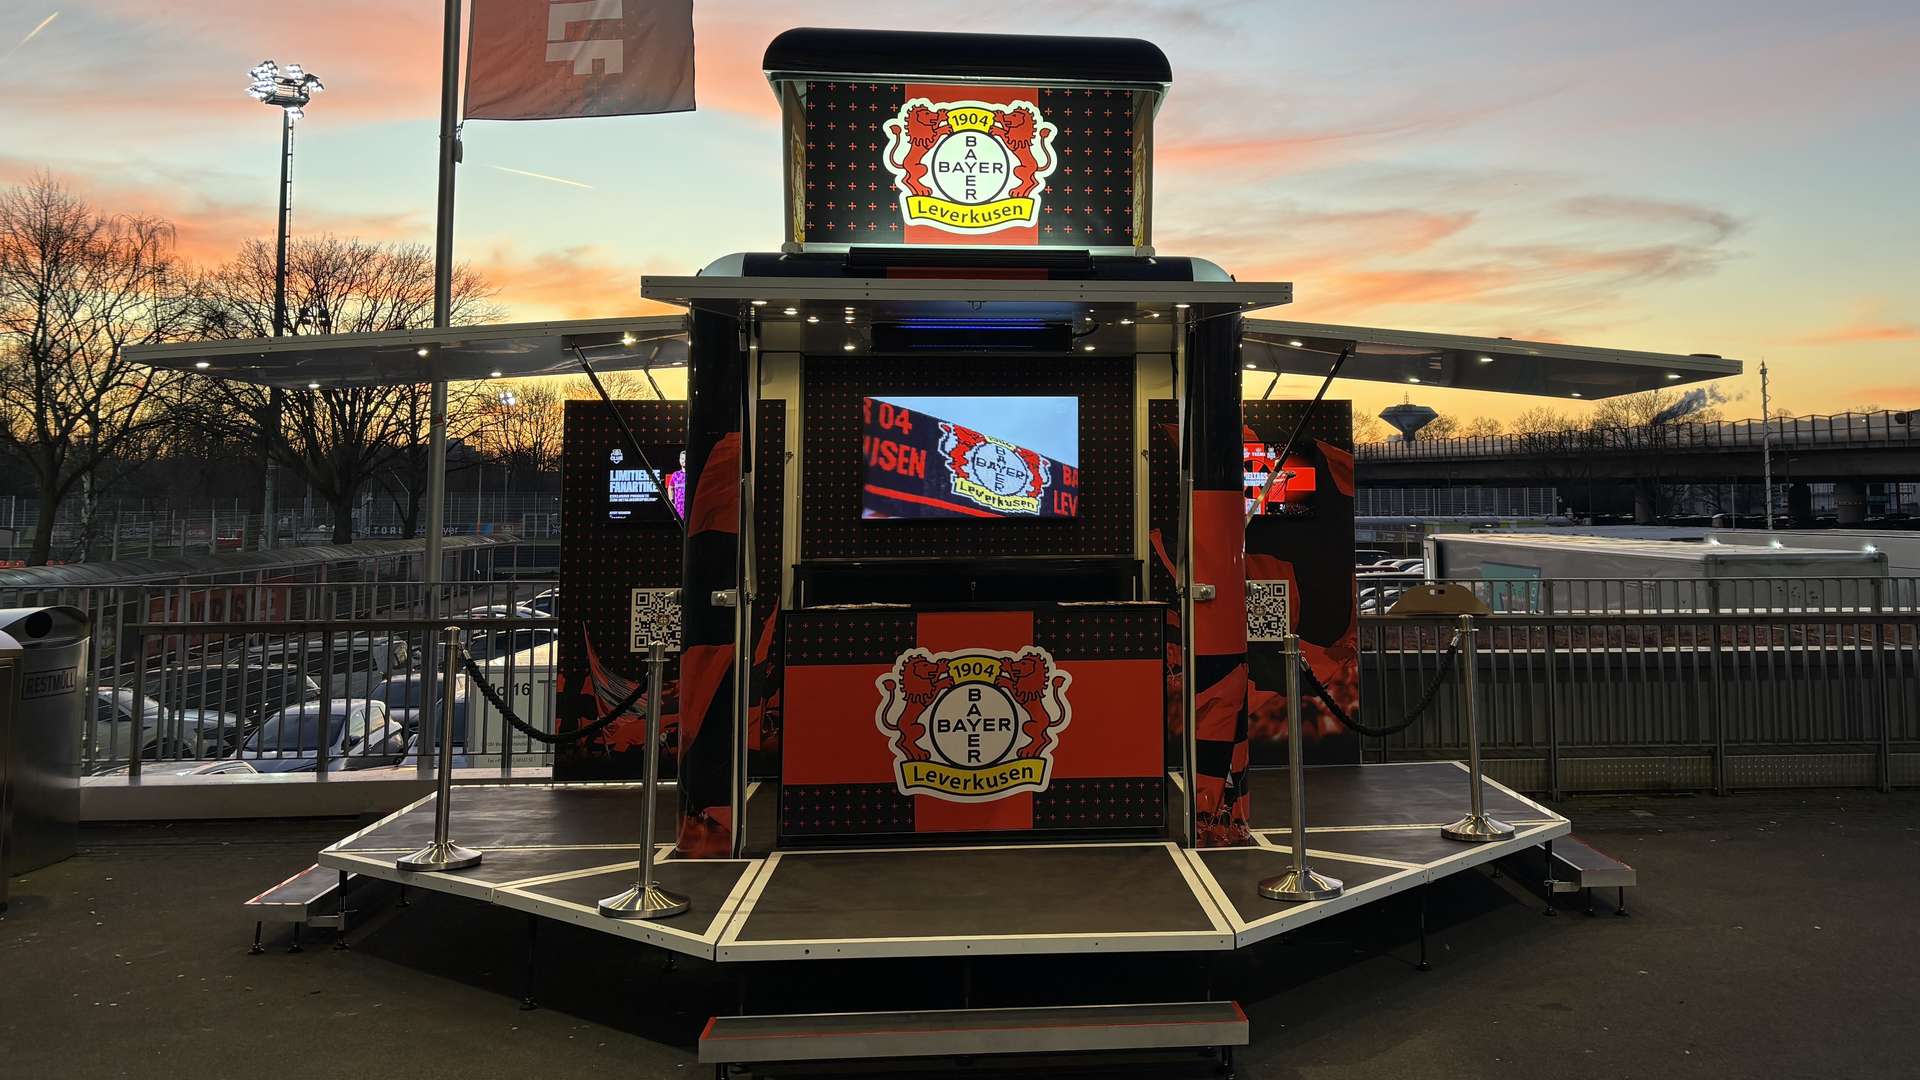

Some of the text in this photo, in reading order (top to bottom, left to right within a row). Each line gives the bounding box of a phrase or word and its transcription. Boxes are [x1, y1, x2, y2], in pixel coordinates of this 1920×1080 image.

[952, 113, 990, 127] 1904
[938, 161, 1003, 174] BAYER
[965, 136, 977, 200] BAYER
[918, 200, 1023, 223] Leverkusen
[879, 403, 912, 435] 04
[610, 469, 660, 481] LIMITIERE
[976, 456, 1025, 480] BAYER
[959, 481, 1035, 509] Leverkusen
[953, 662, 995, 679] 1904
[937, 718, 1011, 733] BAYER
[966, 688, 982, 763] BAYER
[914, 765, 1033, 790] Leverkusen
